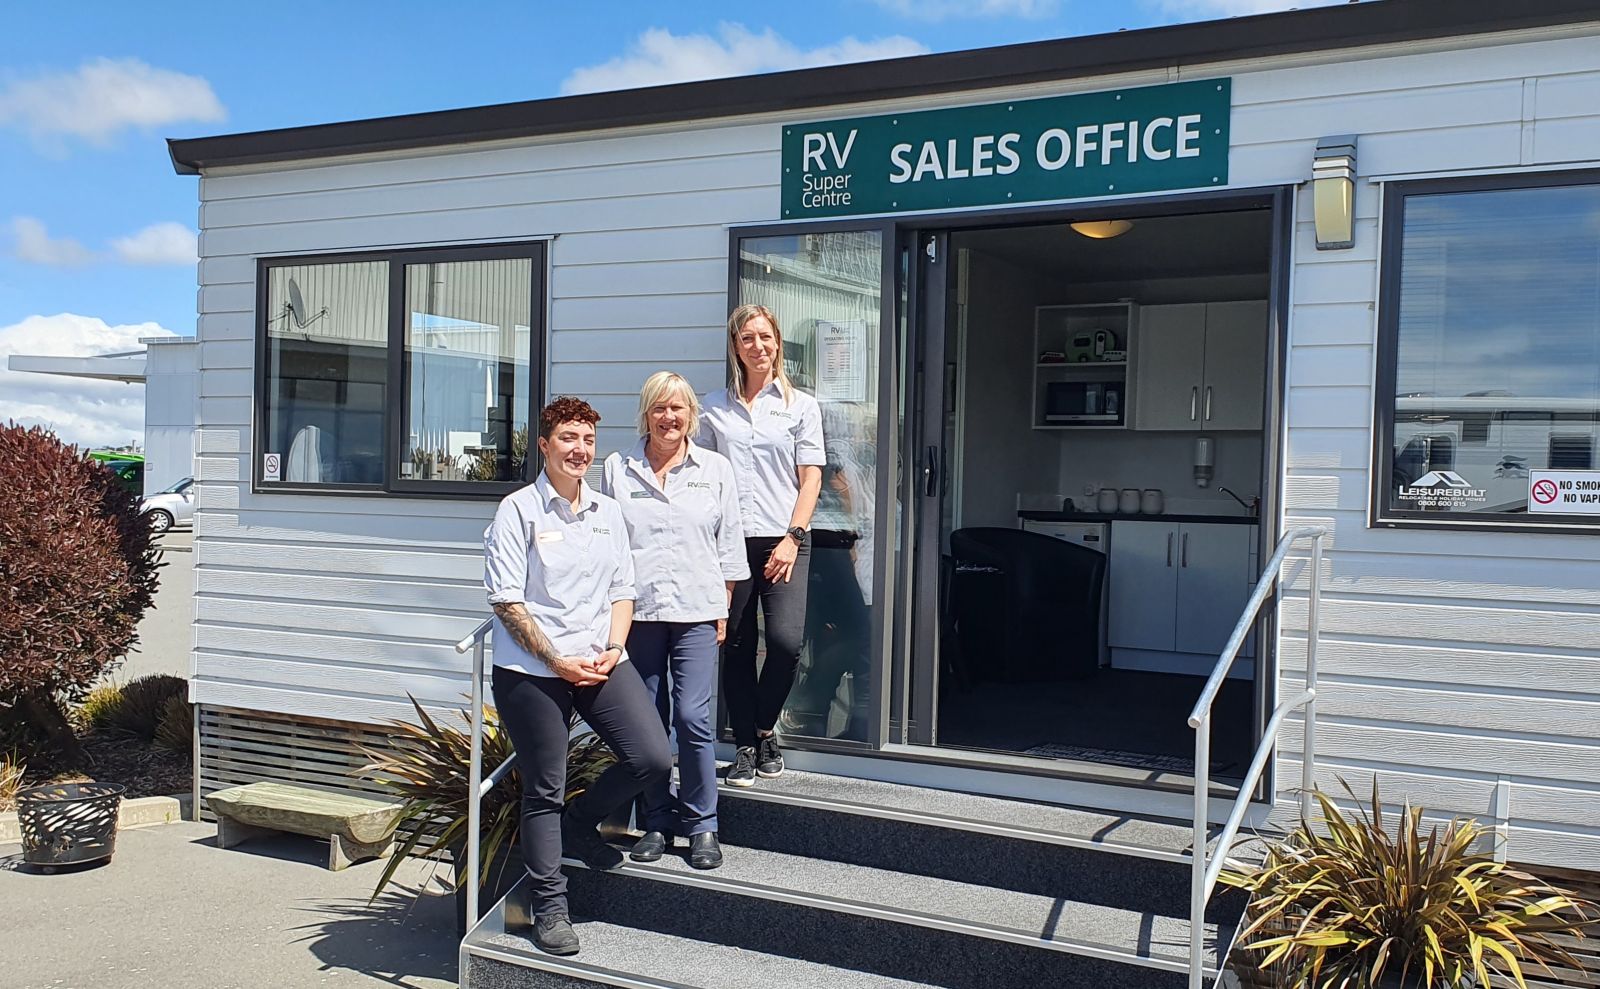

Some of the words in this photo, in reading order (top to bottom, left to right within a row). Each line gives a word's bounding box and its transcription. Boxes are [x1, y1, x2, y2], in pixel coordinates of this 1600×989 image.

[802, 129, 858, 172] RV
[889, 132, 1021, 184] SALES
[1036, 114, 1201, 171] OFFICE
[802, 173, 852, 195] Super
[802, 190, 852, 208] Centre
[1399, 485, 1487, 497] LEISUREBUILT
[1559, 480, 1573, 490] NO
[1563, 493, 1577, 503] NO
